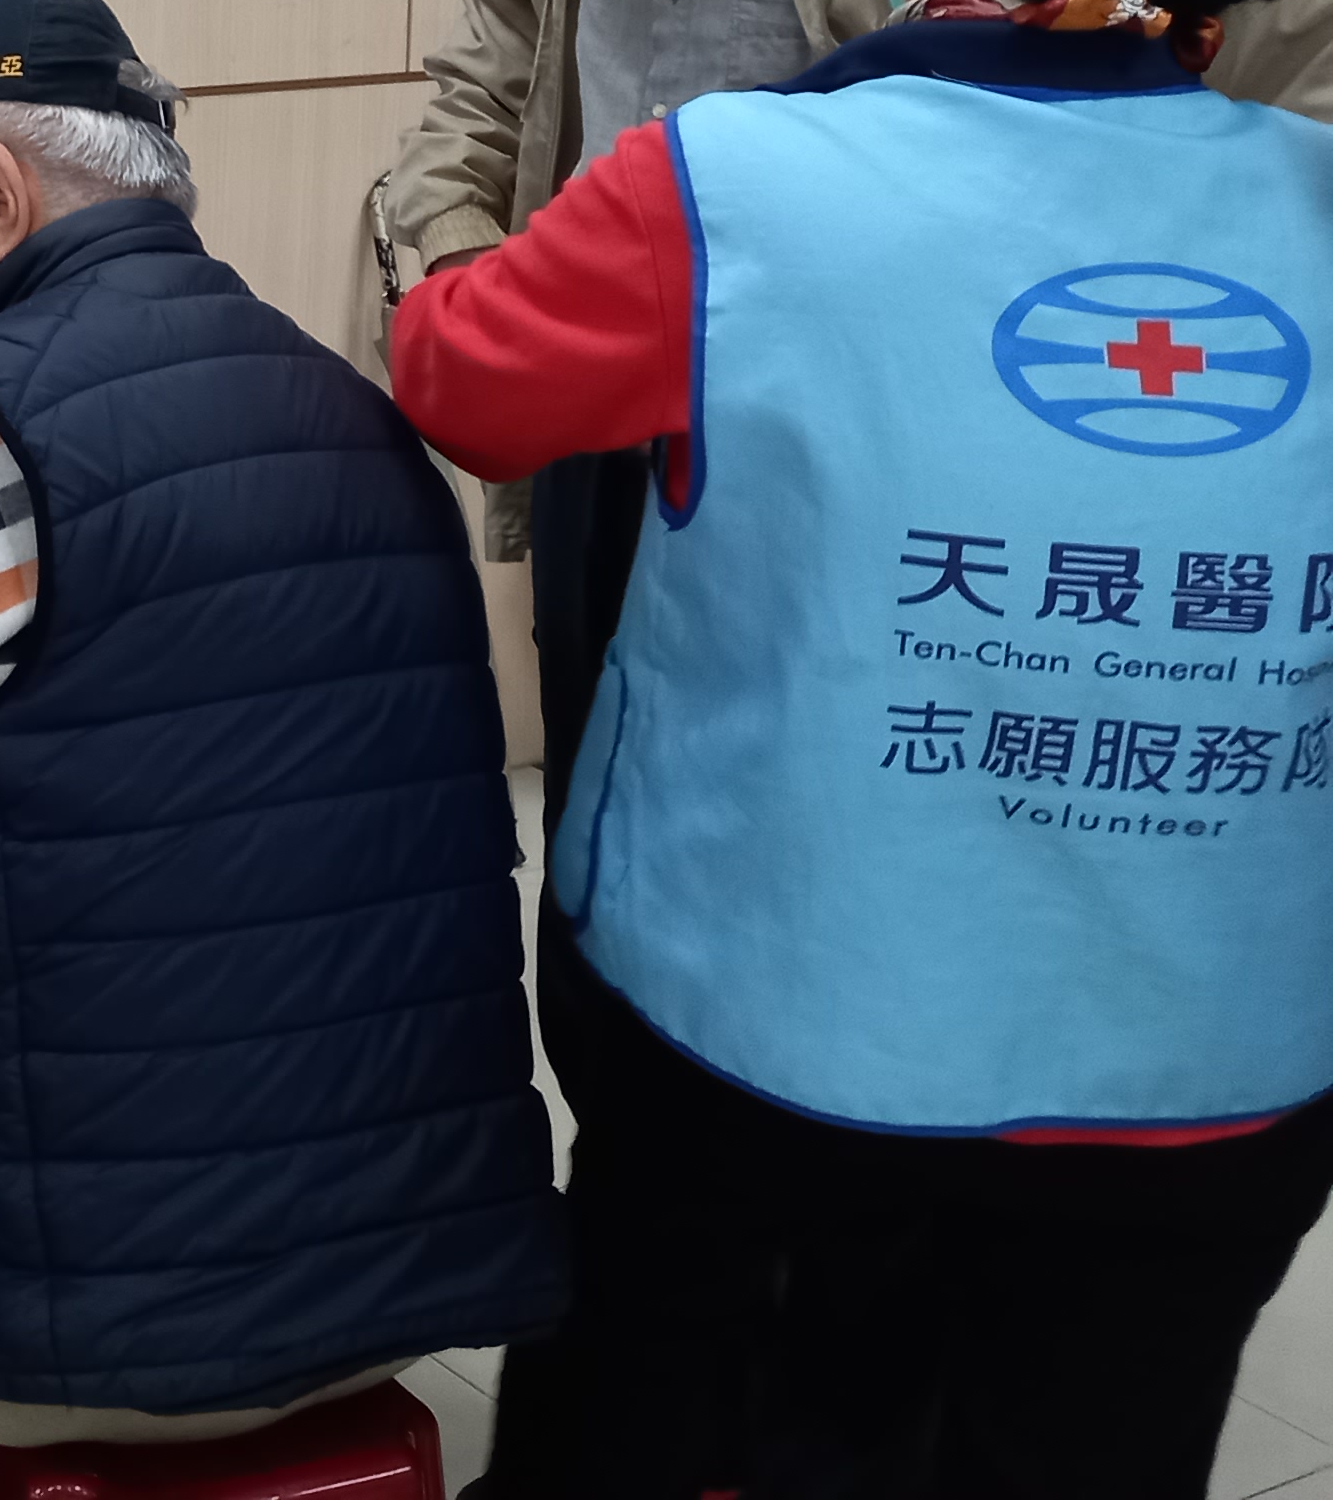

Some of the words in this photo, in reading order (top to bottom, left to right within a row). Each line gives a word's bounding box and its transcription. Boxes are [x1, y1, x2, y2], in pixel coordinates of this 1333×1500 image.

[894, 630, 1070, 675] Ten-Chan
[1094, 651, 1237, 682] General
[998, 796, 1228, 839] Volunteer
